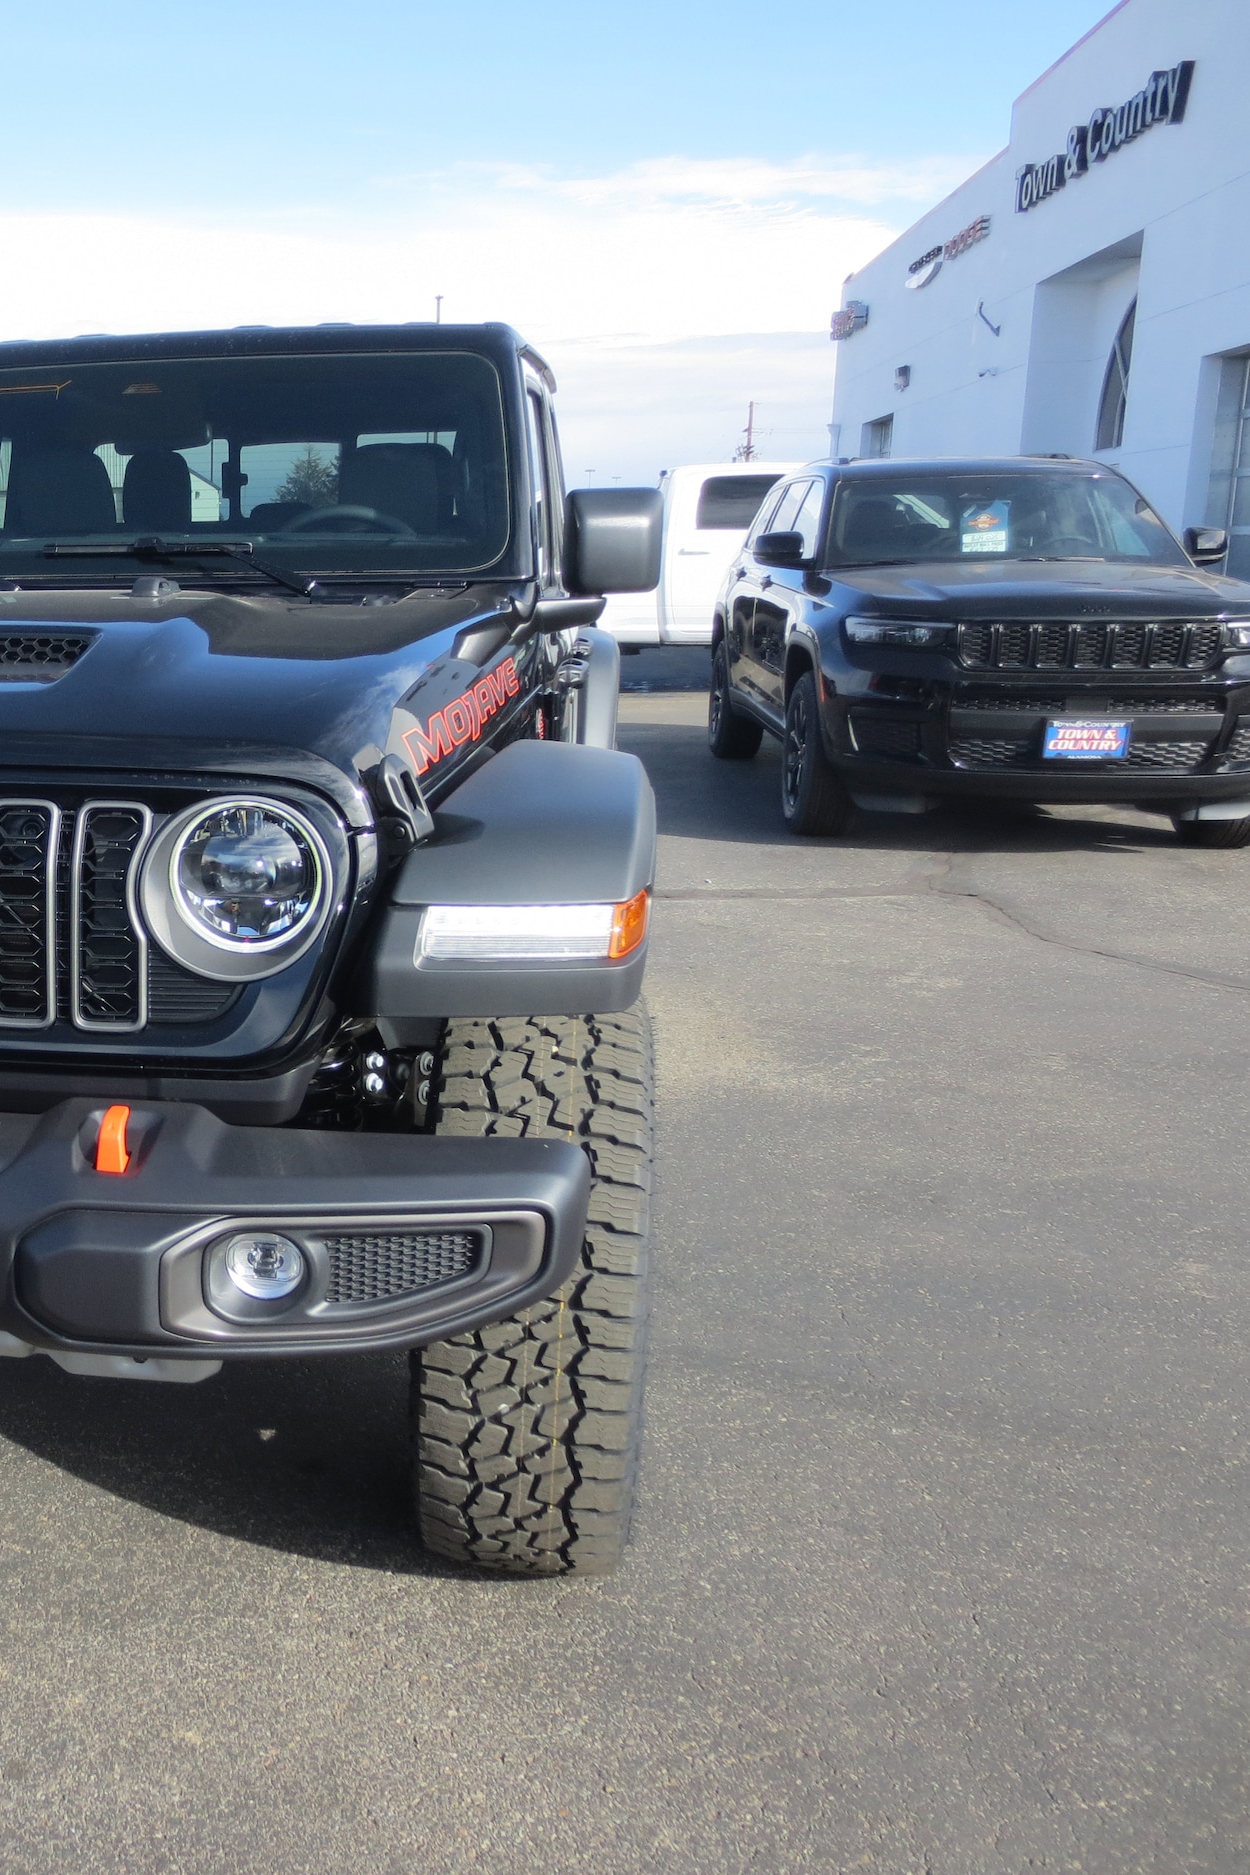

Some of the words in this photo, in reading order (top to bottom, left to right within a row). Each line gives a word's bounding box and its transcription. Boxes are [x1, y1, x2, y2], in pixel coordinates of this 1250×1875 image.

[1014, 155, 1067, 213] Town
[1064, 126, 1089, 179] &
[1086, 60, 1196, 163] Country
[401, 657, 520, 776] MOJAVE
[1048, 739, 1123, 751] COUNTRY
[1057, 728, 1104, 740] TOWN
[1104, 729, 1117, 740] &
